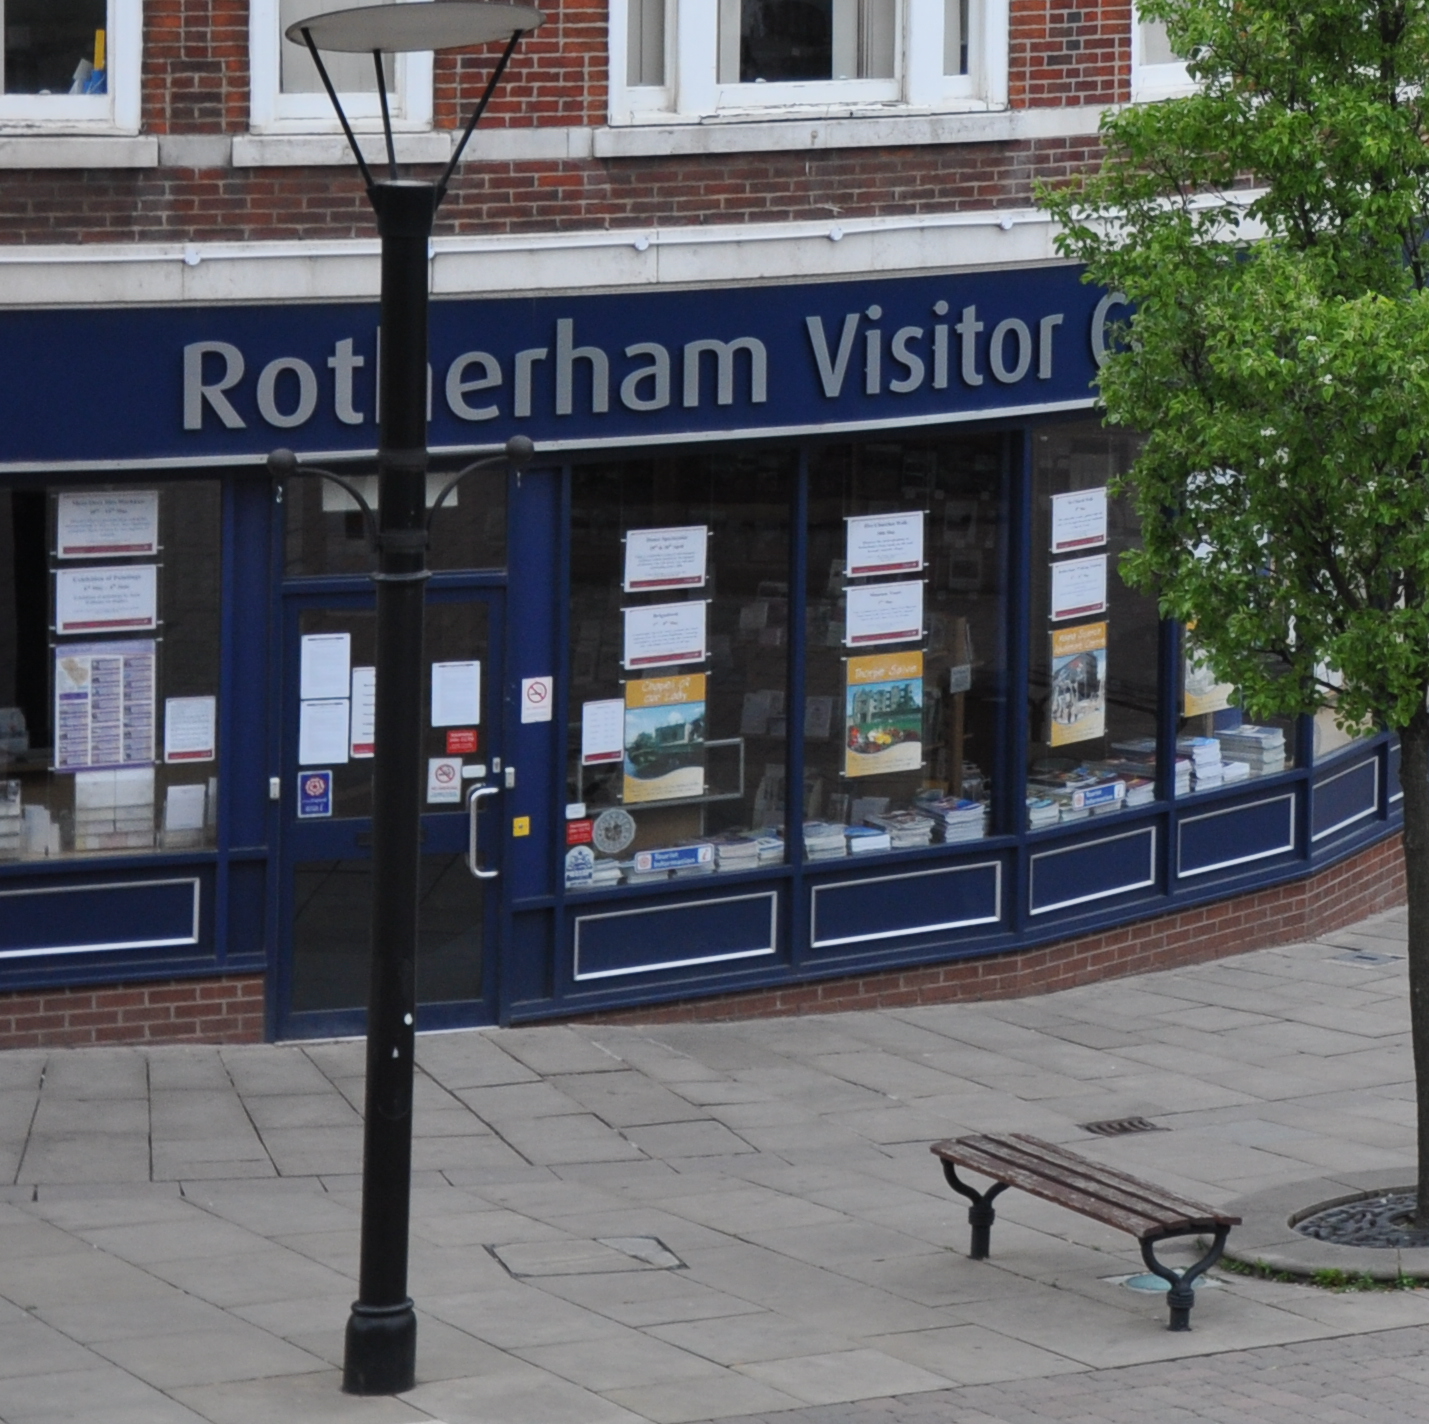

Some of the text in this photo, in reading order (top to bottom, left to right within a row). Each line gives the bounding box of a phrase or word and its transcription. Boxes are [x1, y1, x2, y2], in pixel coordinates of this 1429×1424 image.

[183, 318, 767, 430] Roterham
[805, 300, 1064, 398] Visitor
[653, 851, 679, 860] Tourist
[653, 856, 696, 868] Information
